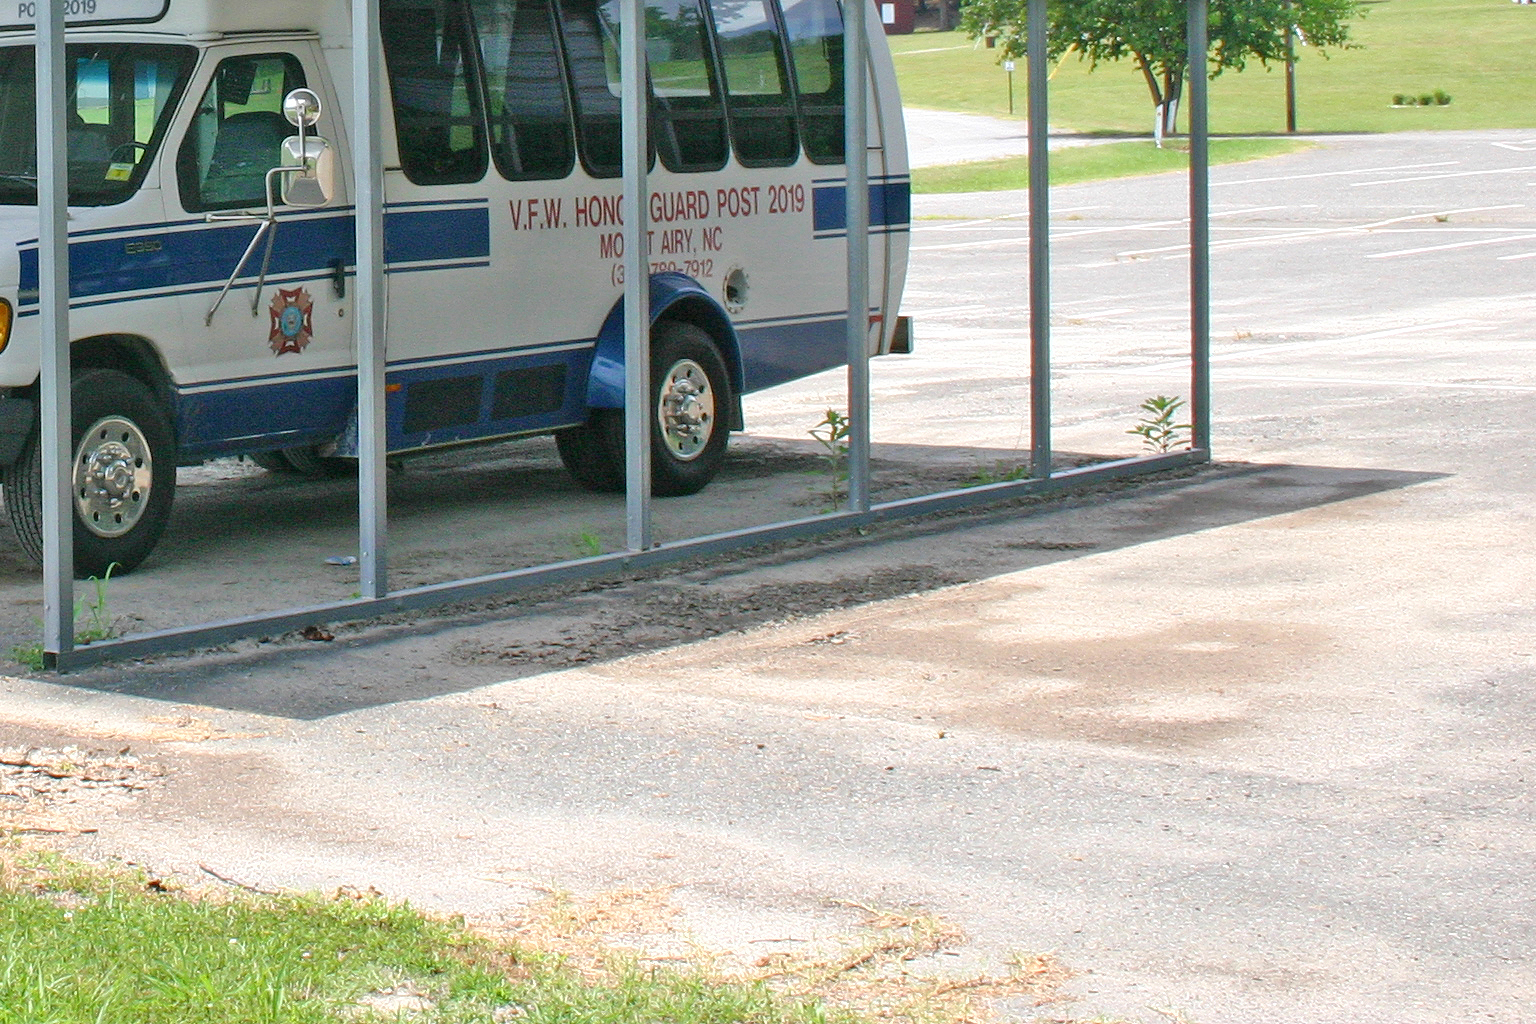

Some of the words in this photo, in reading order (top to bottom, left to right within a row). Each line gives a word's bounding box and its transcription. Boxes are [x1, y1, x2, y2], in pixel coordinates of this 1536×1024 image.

[509, 198, 567, 230] V.F.W.
[575, 194, 624, 227] HONO
[649, 190, 710, 223] GUARD
[717, 187, 761, 218] POST
[768, 184, 805, 214] 2019
[600, 230, 654, 258] MOT
[661, 228, 697, 254] AIRY,
[702, 226, 723, 251] NC
